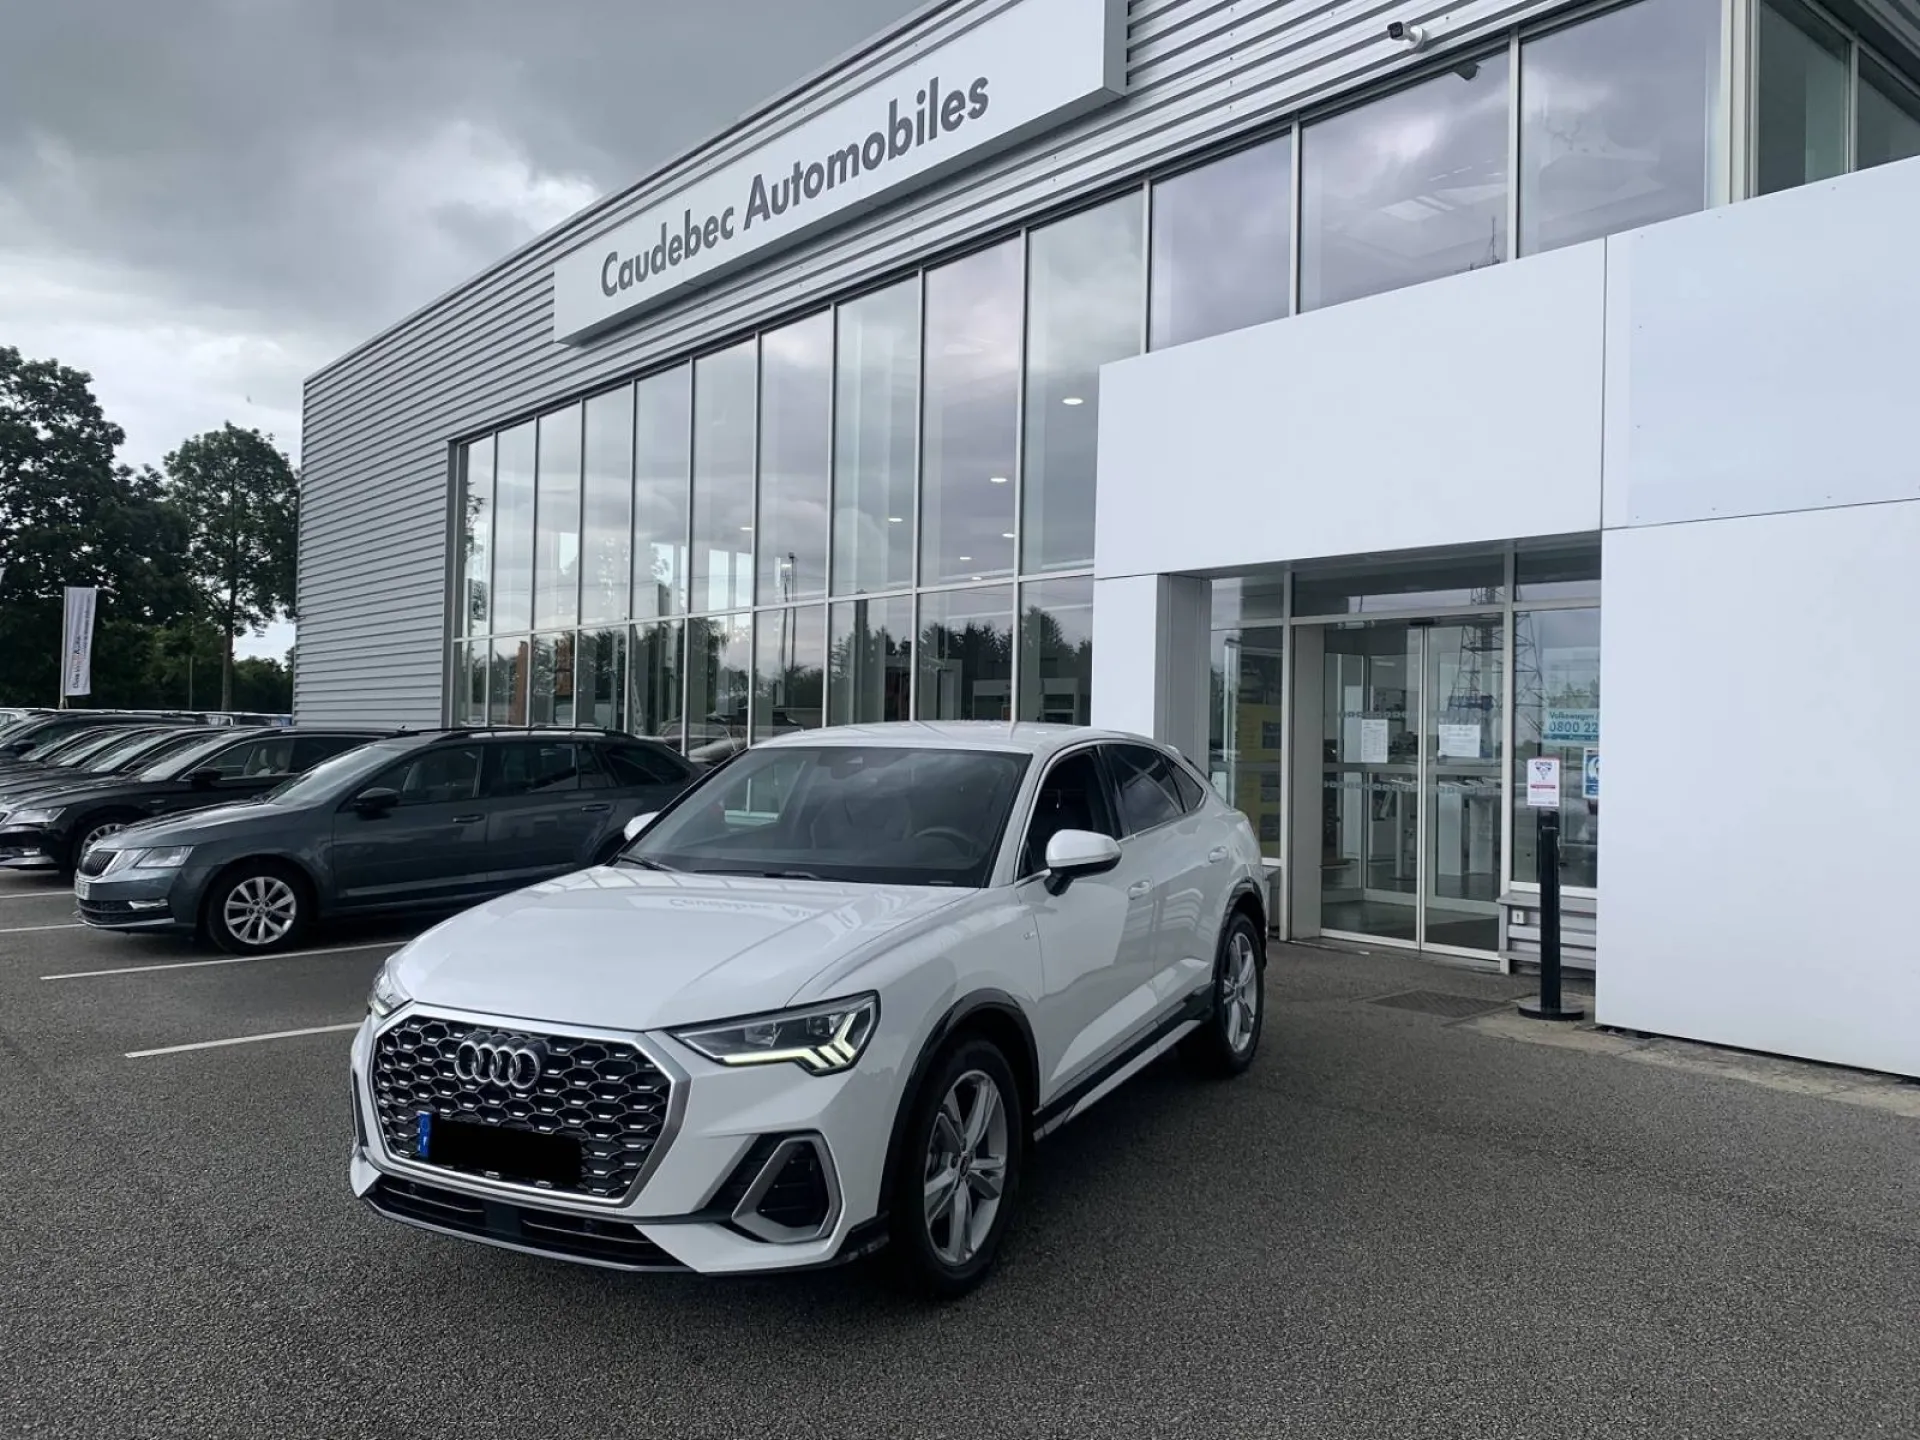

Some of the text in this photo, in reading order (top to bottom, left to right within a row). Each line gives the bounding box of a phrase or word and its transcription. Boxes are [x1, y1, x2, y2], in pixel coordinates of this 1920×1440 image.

[601, 76, 989, 297] Caudebec Automobiles
[1550, 711, 1594, 721] Volkswagen
[1549, 720, 1580, 732] 0800
